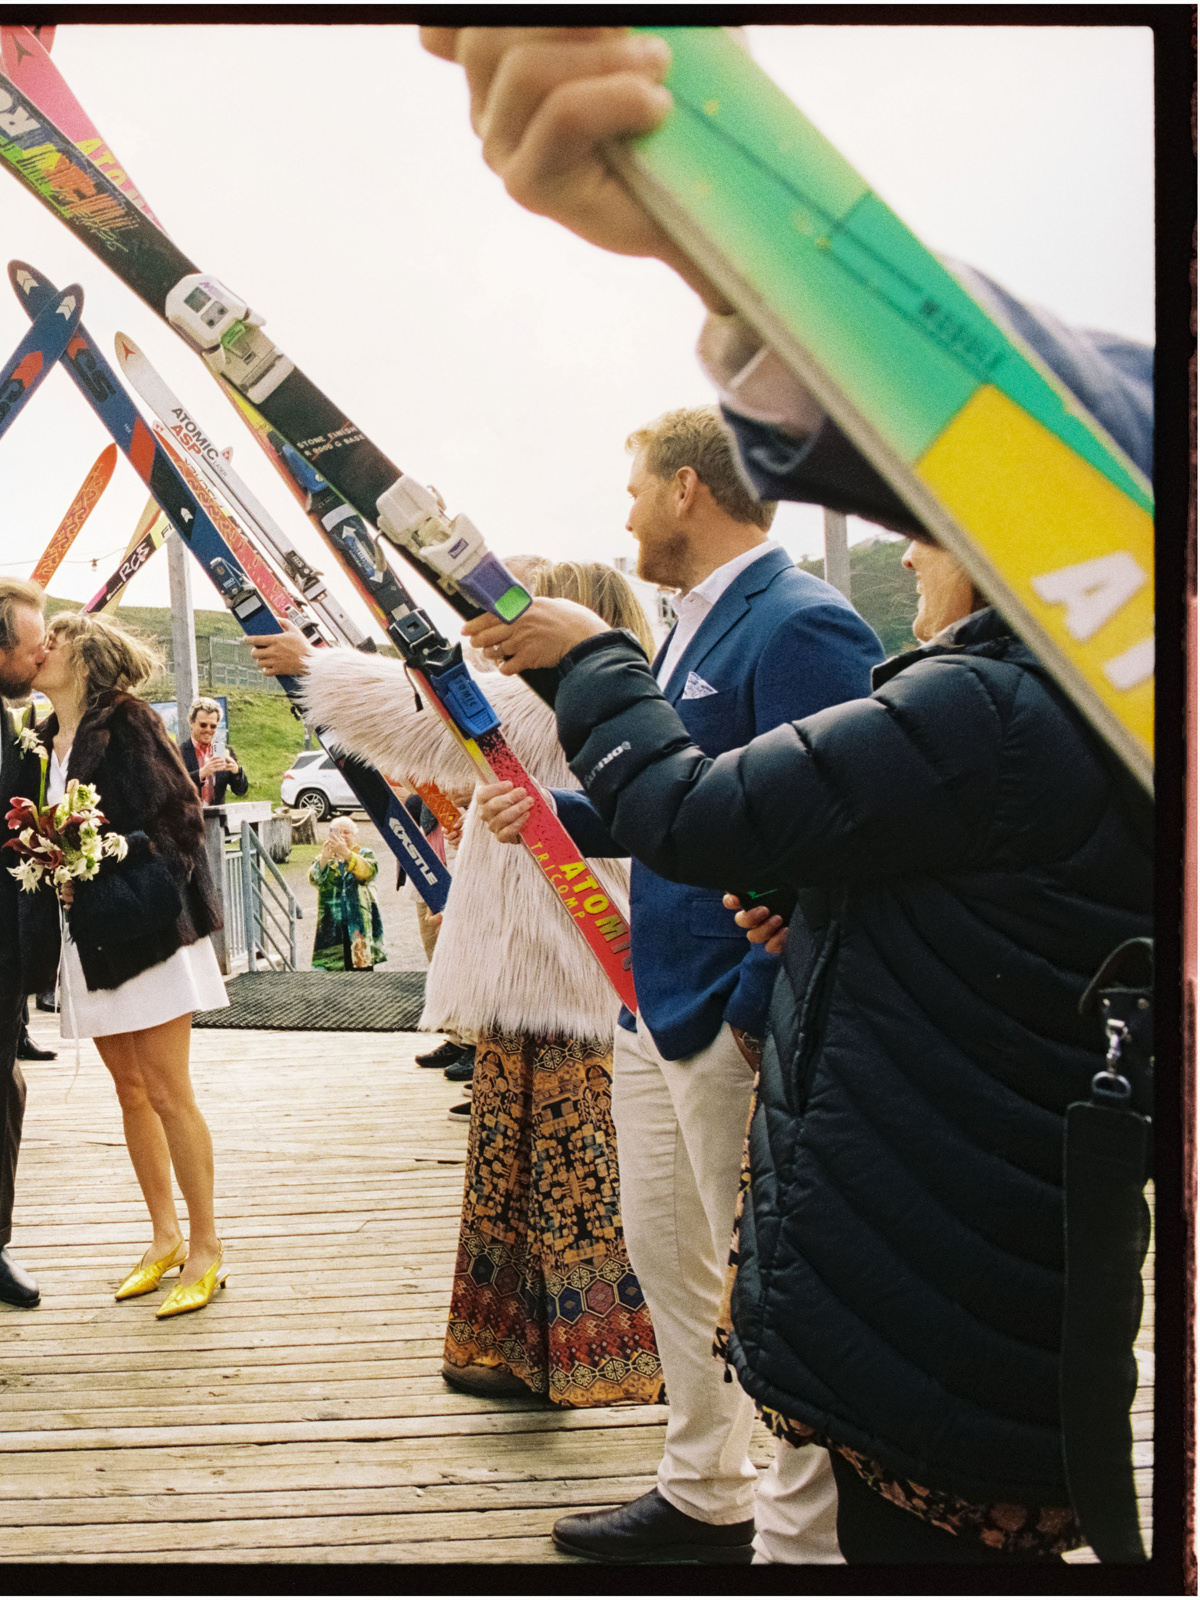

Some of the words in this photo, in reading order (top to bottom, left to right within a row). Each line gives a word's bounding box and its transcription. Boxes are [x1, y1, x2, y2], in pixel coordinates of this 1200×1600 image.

[171, 407, 218, 461] ATOMIC
[171, 424, 201, 455] ASP
[297, 435, 326, 449] STONE
[327, 426, 358, 441] FINISH
[343, 433, 366, 446] BASE
[530, 841, 586, 919] TRICOMP
